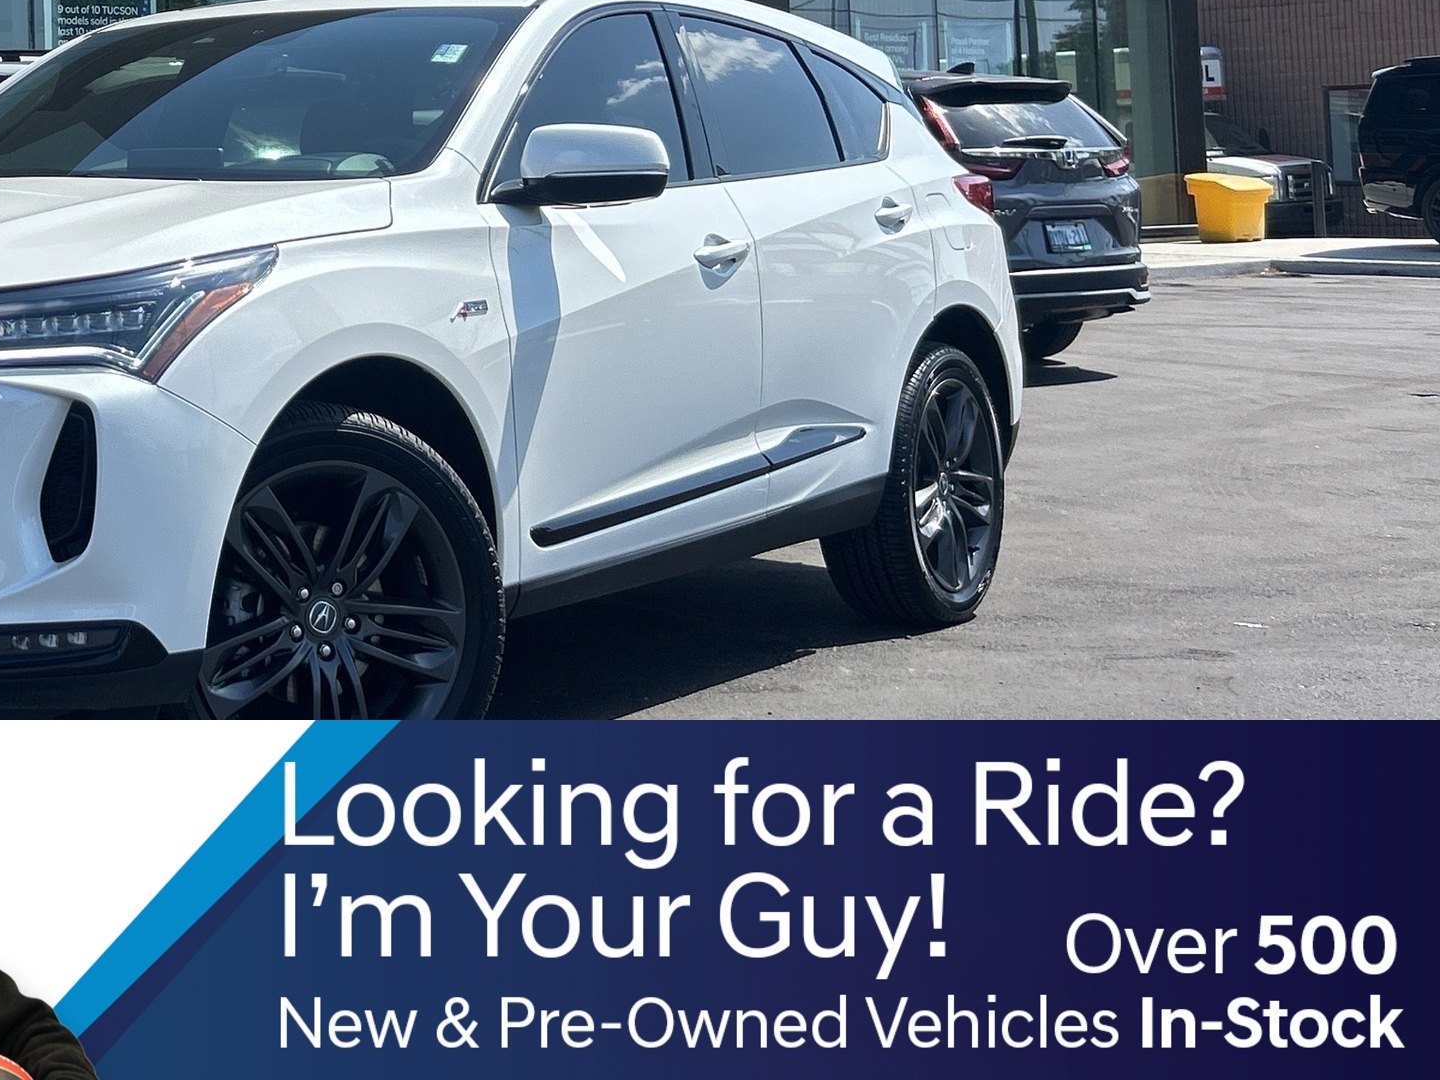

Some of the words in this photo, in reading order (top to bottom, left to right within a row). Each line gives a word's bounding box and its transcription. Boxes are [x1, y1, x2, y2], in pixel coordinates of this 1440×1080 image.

[57, 5, 63, 14] 9
[65, 6, 80, 14] out
[81, 5, 91, 14] of
[92, 6, 100, 14] 10
[102, 6, 139, 15] TUCSON
[58, 16, 89, 25] models
[90, 16, 108, 25] sold
[58, 27, 74, 36] last
[75, 27, 84, 35] 10
